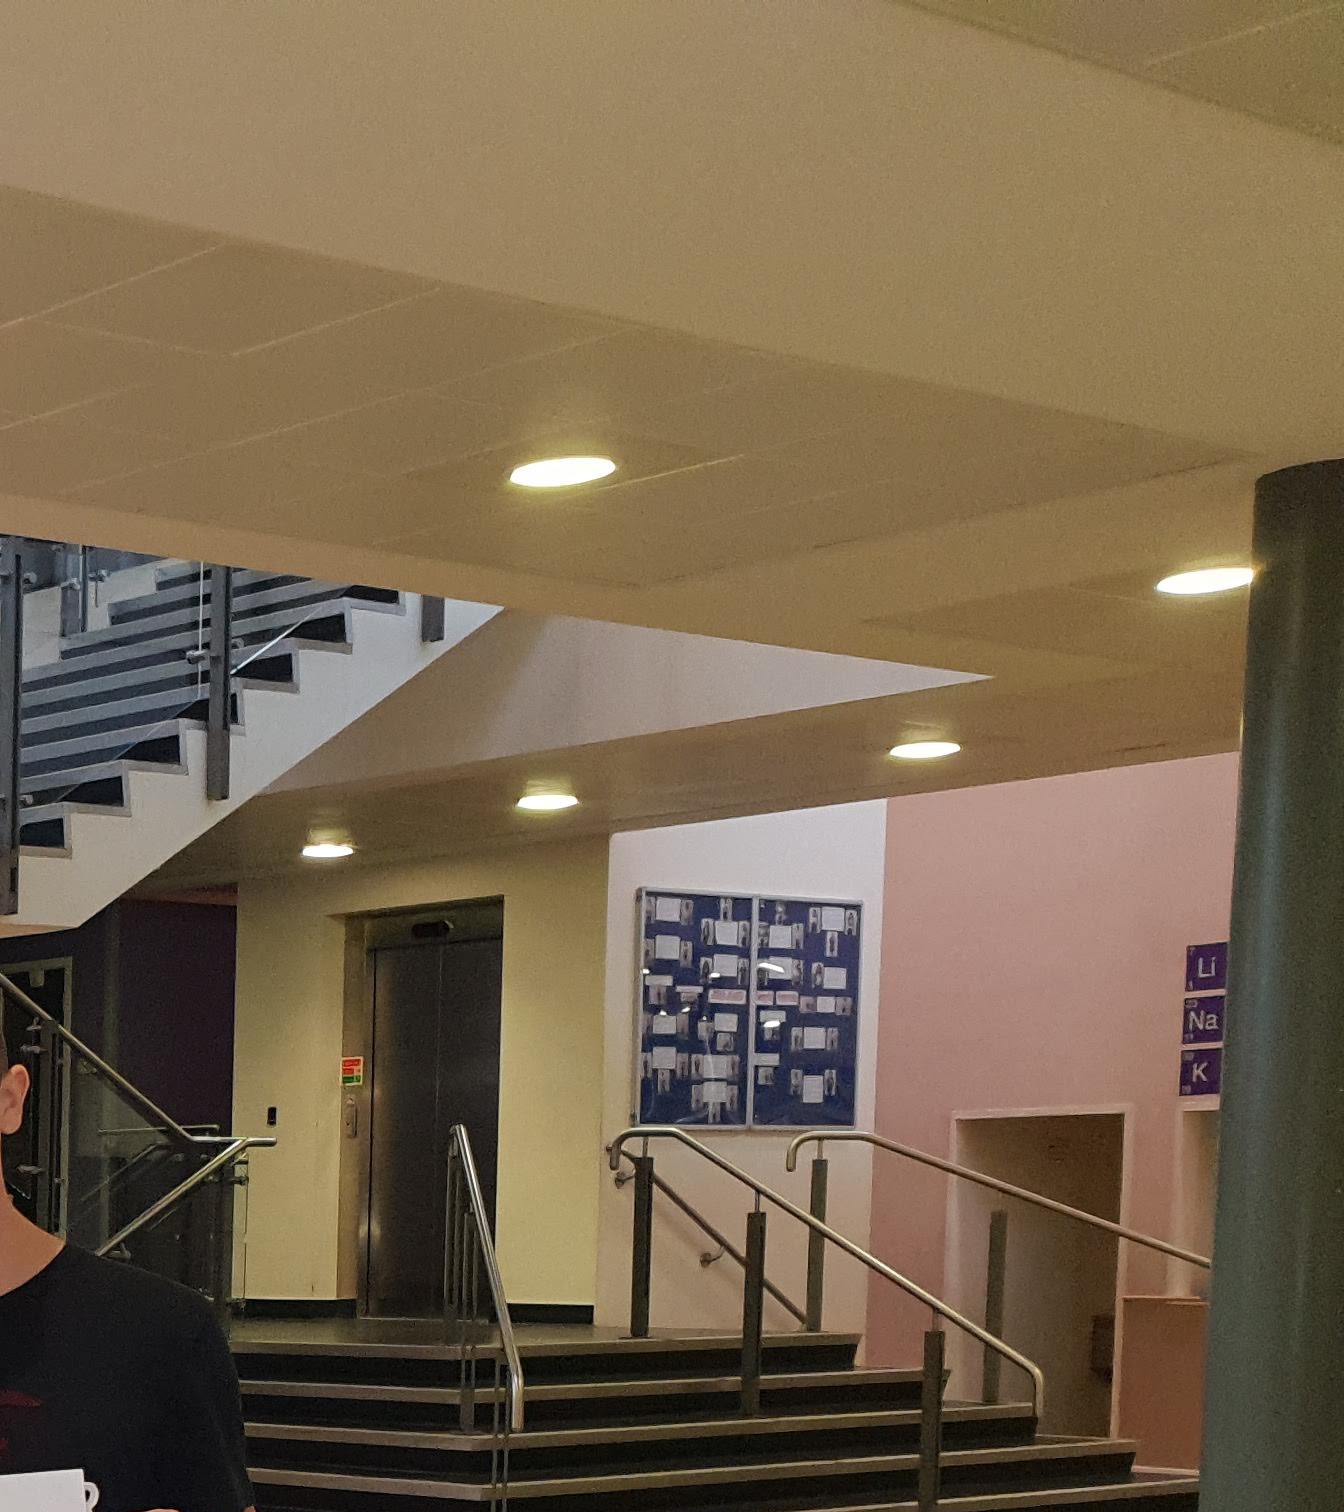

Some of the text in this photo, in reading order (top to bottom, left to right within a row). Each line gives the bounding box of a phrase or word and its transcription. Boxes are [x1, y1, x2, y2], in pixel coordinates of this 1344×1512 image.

[1198, 957, 1216, 979] Li
[1188, 1010, 1219, 1032] Na
[1192, 1061, 1209, 1082] K
